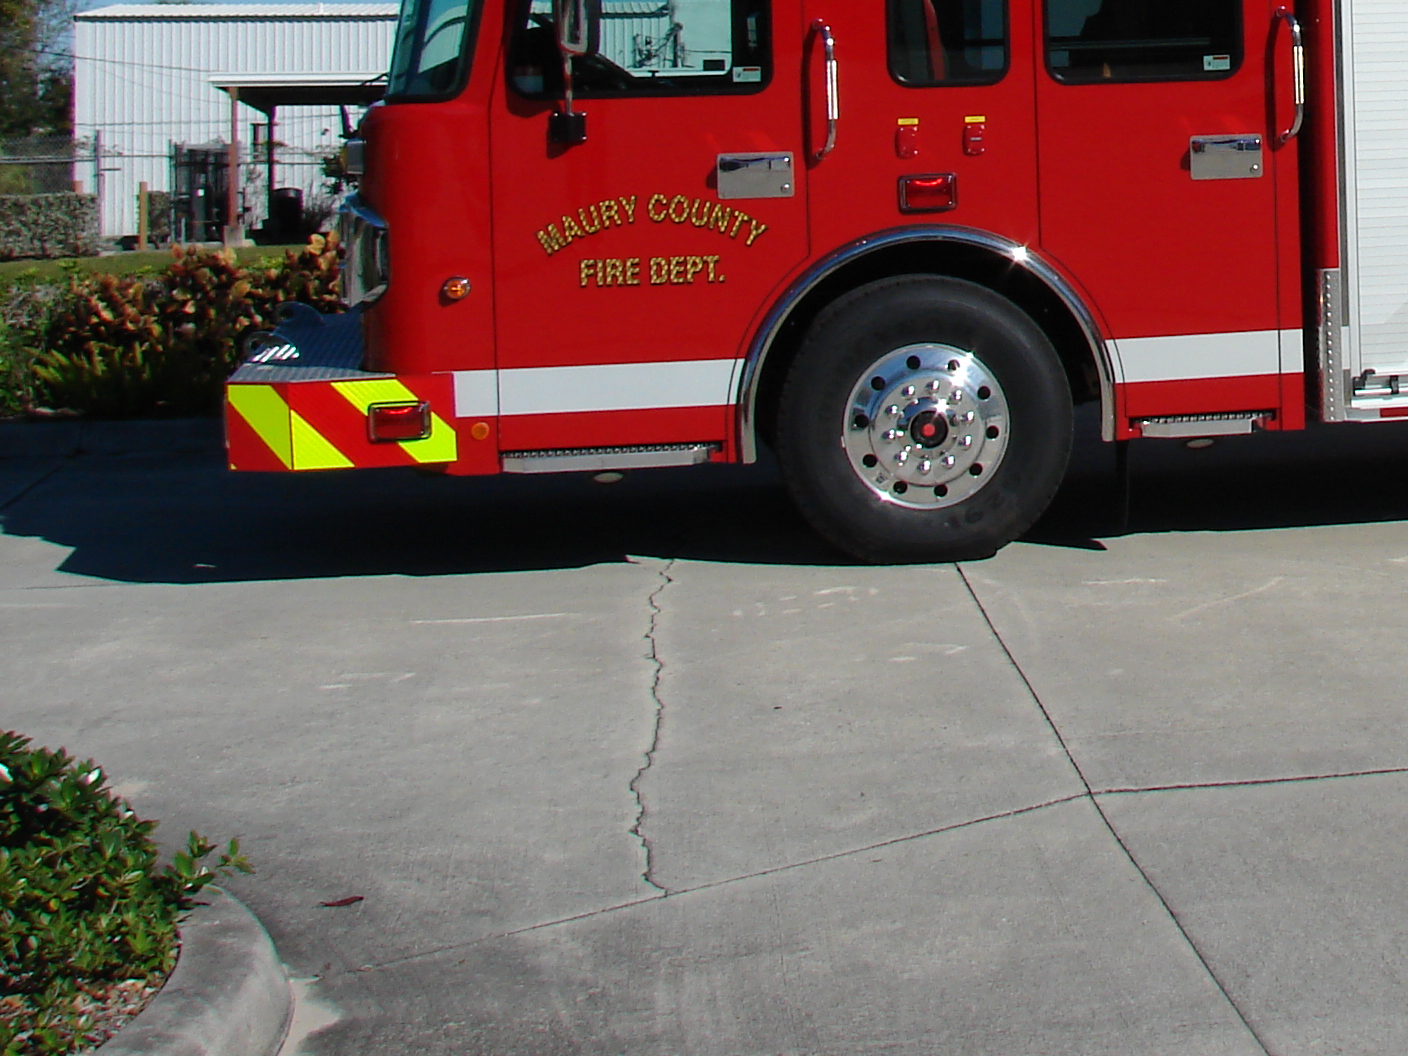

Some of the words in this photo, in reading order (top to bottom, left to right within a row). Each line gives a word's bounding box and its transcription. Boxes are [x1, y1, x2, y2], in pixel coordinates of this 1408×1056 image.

[537, 195, 637, 255] MAURY
[648, 193, 768, 246] COUNTY
[580, 258, 640, 286] FIRE
[650, 254, 726, 285] DEPT.
